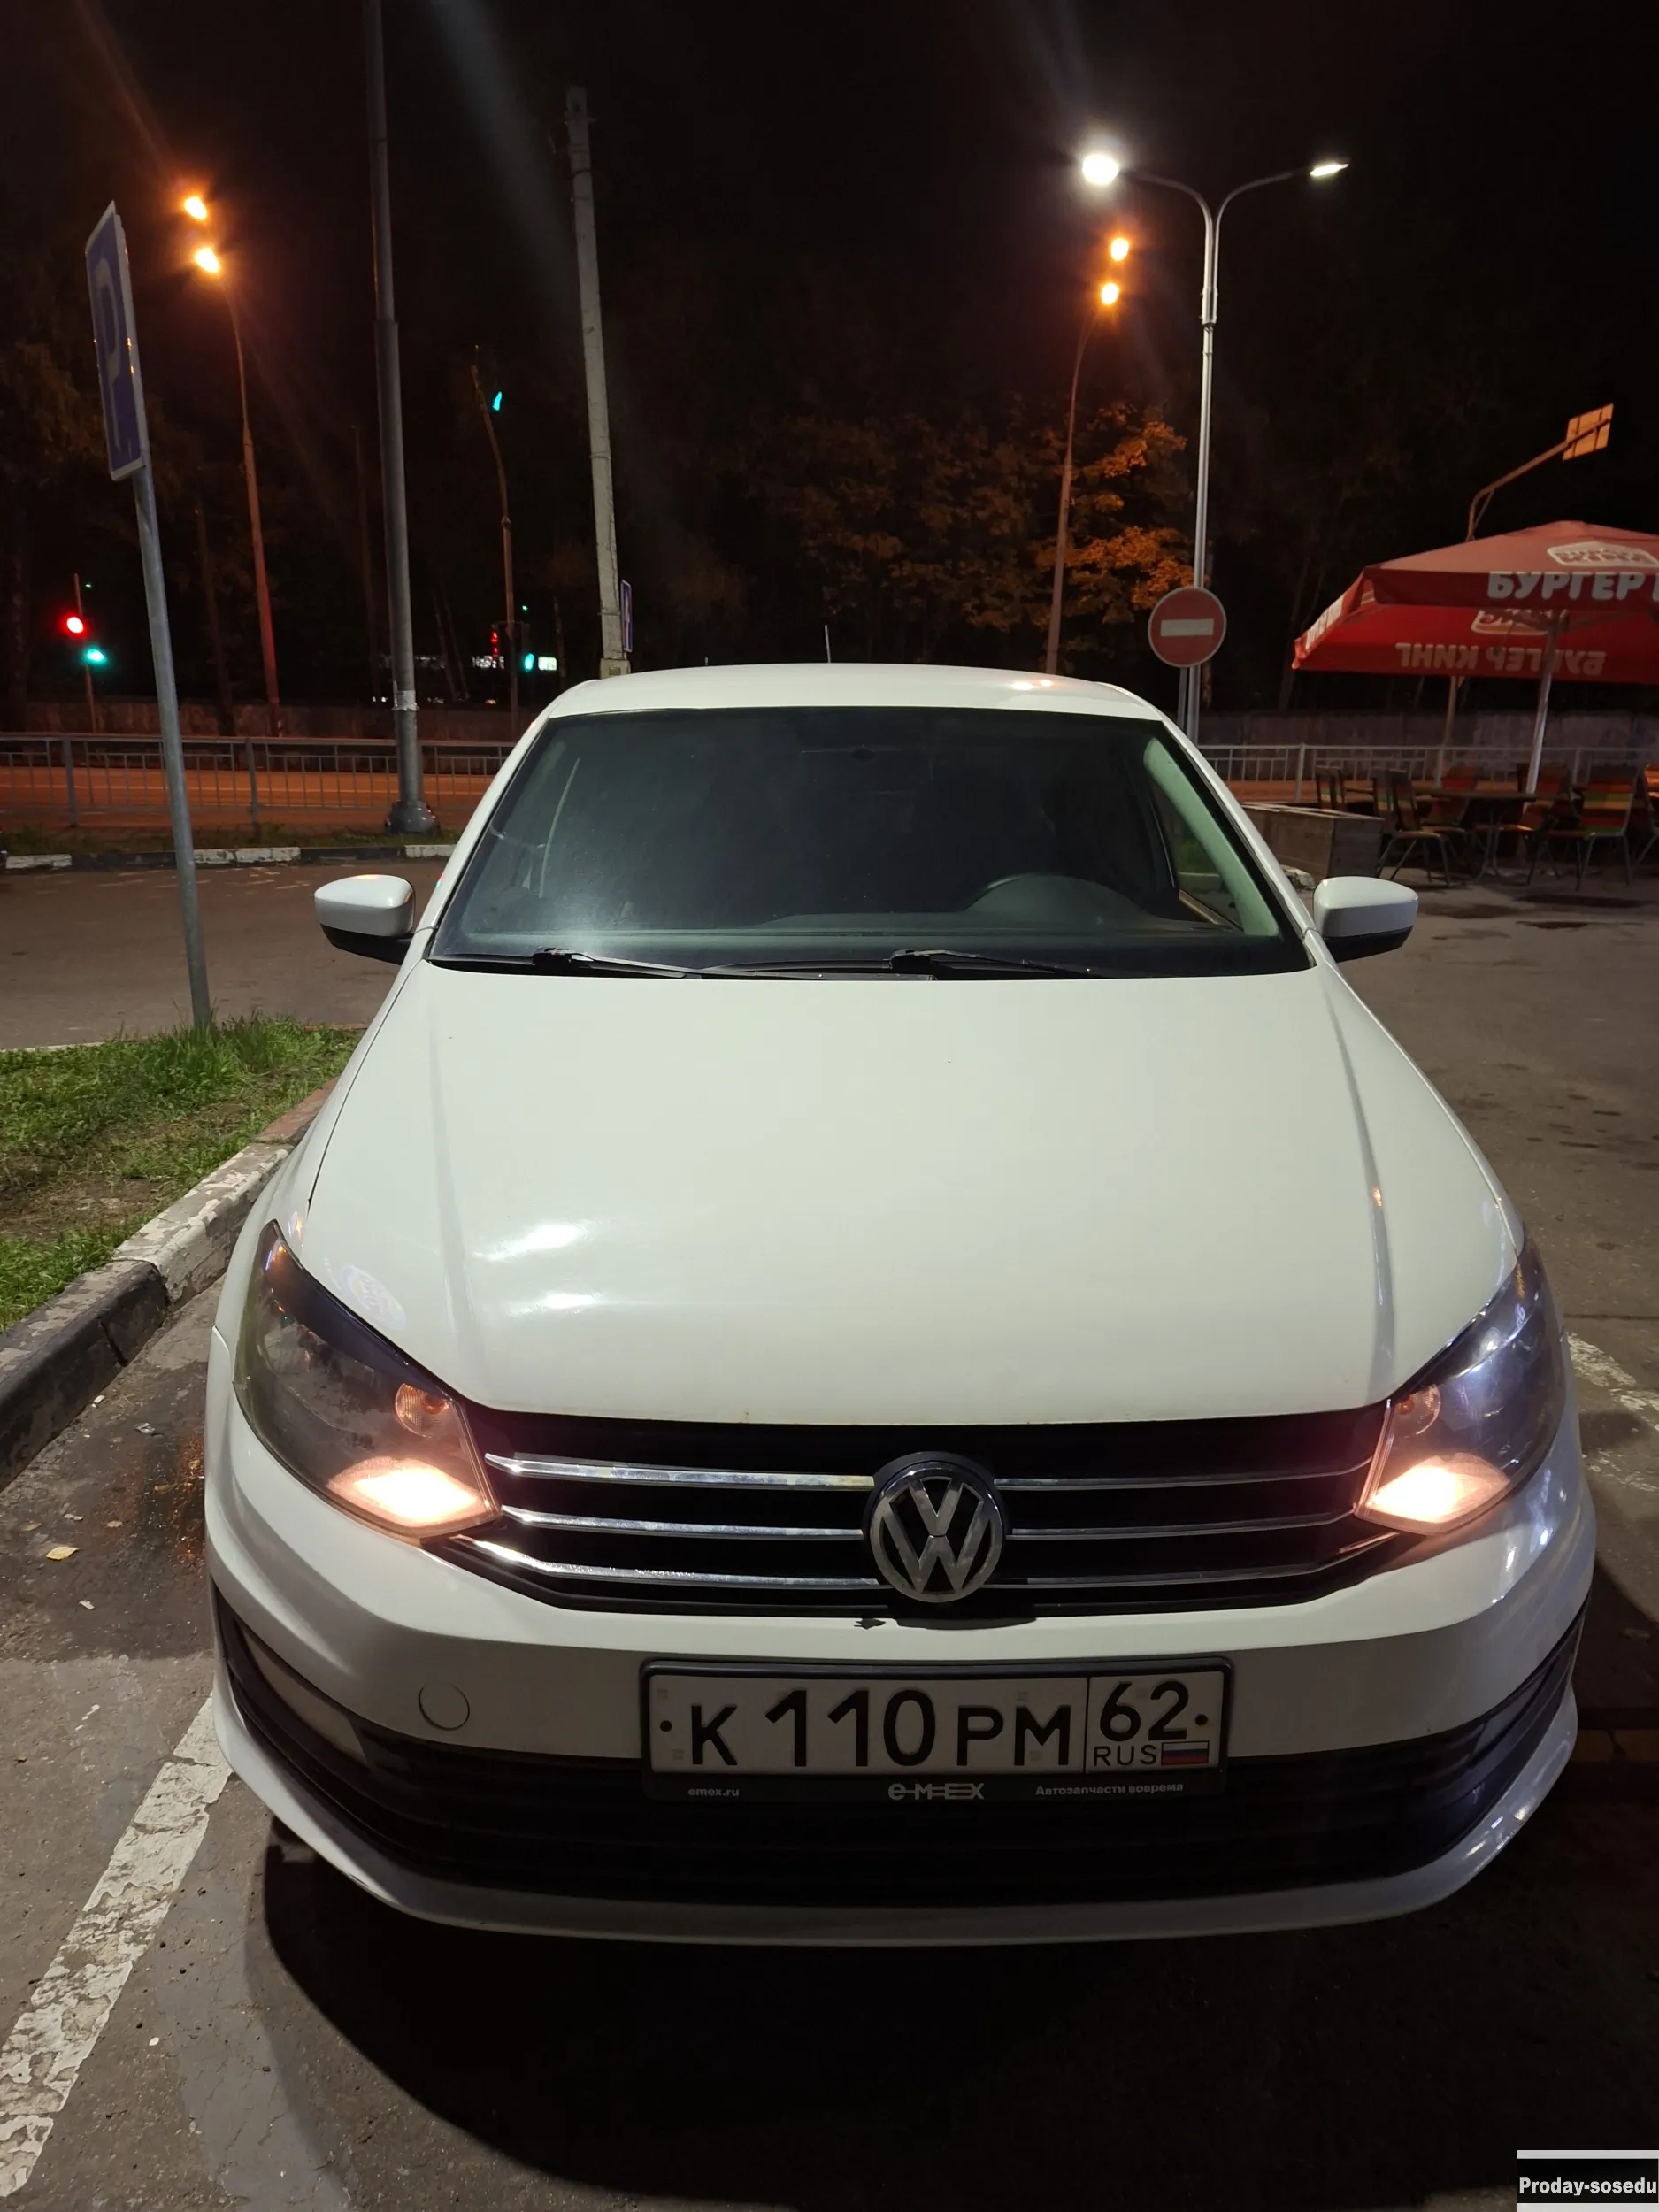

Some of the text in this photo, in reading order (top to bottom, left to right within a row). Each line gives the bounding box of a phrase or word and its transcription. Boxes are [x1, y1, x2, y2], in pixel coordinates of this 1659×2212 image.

[1486, 571, 1646, 602] БУРГЕР
[1099, 1679, 1189, 1741] 62
[1094, 1744, 1158, 1767] RUS
[687, 1787, 740, 1798] emex.ru
[1034, 1783, 1184, 1796] Автозапчасти вовремя
